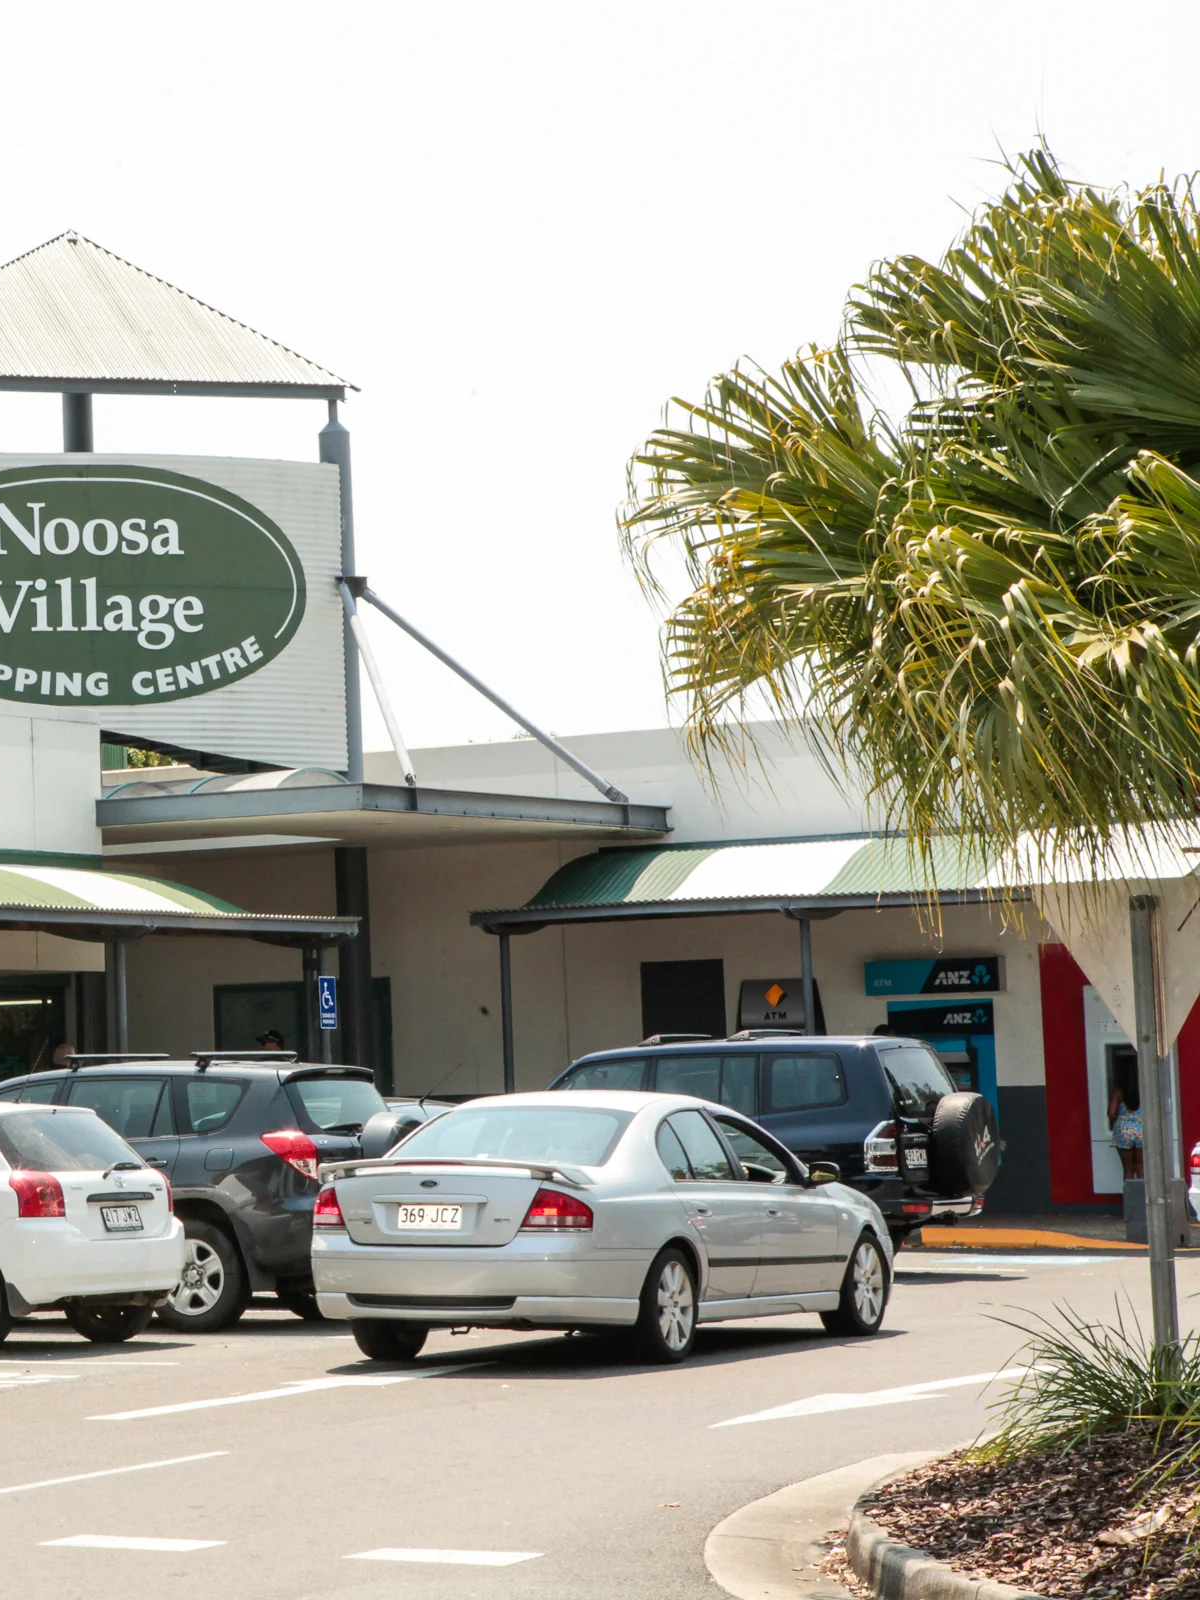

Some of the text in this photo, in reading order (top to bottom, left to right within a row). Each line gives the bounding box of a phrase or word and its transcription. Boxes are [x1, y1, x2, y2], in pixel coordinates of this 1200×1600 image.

[132, 634, 264, 697] CENTRE
[873, 970, 971, 988] ATM ANZ
[763, 1011, 787, 1021] ATM
[943, 1012, 972, 1025] ANZ
